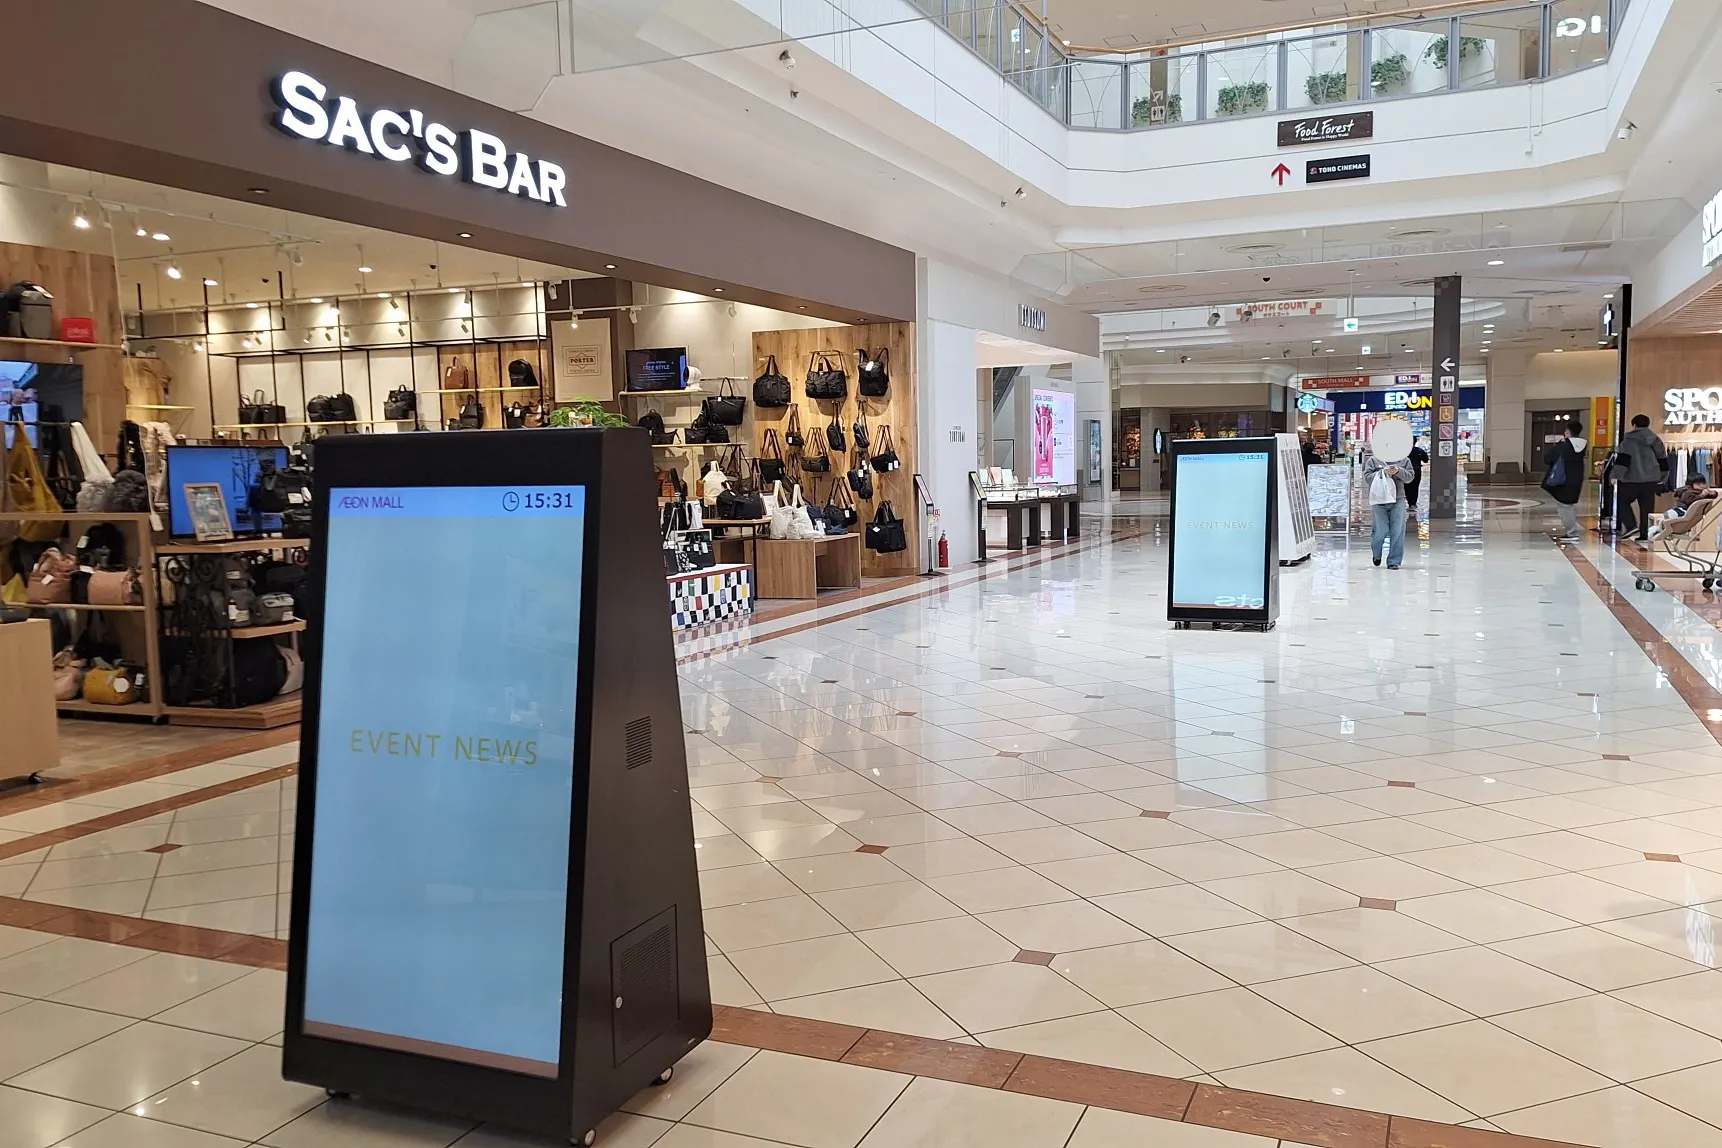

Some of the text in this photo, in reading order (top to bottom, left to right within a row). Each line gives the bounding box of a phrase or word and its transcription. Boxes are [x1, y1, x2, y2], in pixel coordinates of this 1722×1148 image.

[1294, 118, 1355, 138] Food Forest
[280, 70, 567, 207] SAC'S BAR
[1318, 163, 1367, 174] TOHO CINEMAS
[1247, 301, 1308, 313] SOUTH COURT
[1384, 391, 1433, 409] EDION
[1663, 386, 1722, 412] SPO
[371, 496, 404, 509] MALL
[524, 492, 573, 509] 15:31
[1187, 521, 1254, 529] EVENT NEWS
[351, 729, 537, 765] EVENT NEWS
